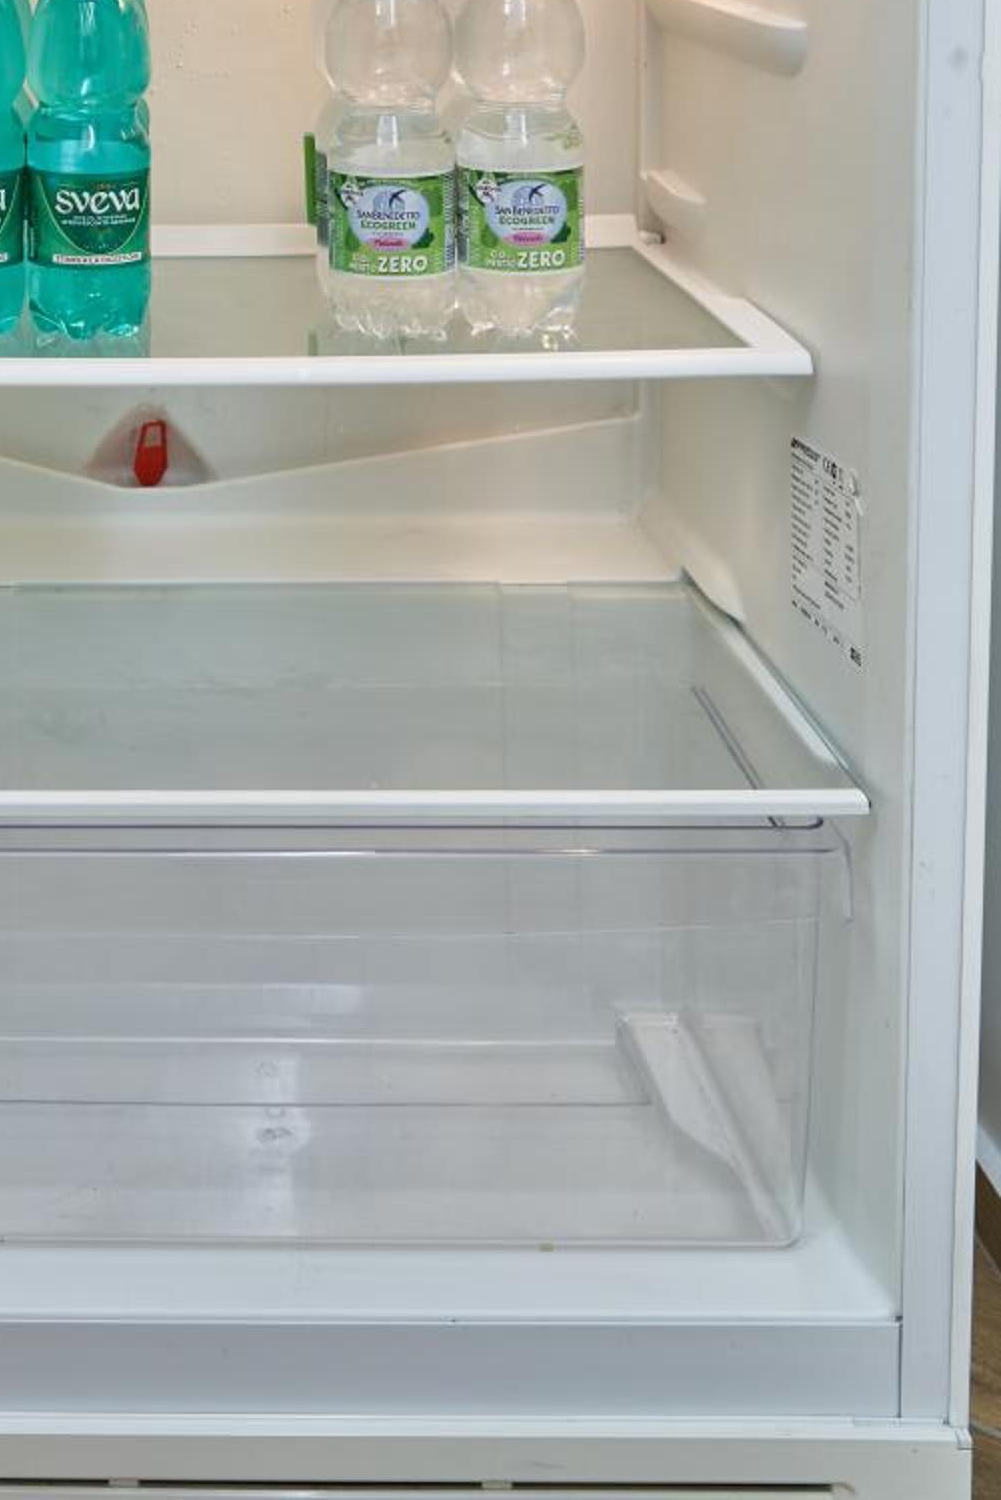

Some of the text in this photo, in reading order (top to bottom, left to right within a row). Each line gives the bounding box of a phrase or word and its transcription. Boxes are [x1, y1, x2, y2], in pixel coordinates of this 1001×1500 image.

[54, 187, 140, 215] sveva
[360, 220, 416, 230] ECOGREEN
[378, 255, 428, 273] ZERO
[517, 250, 566, 268] ZERO
